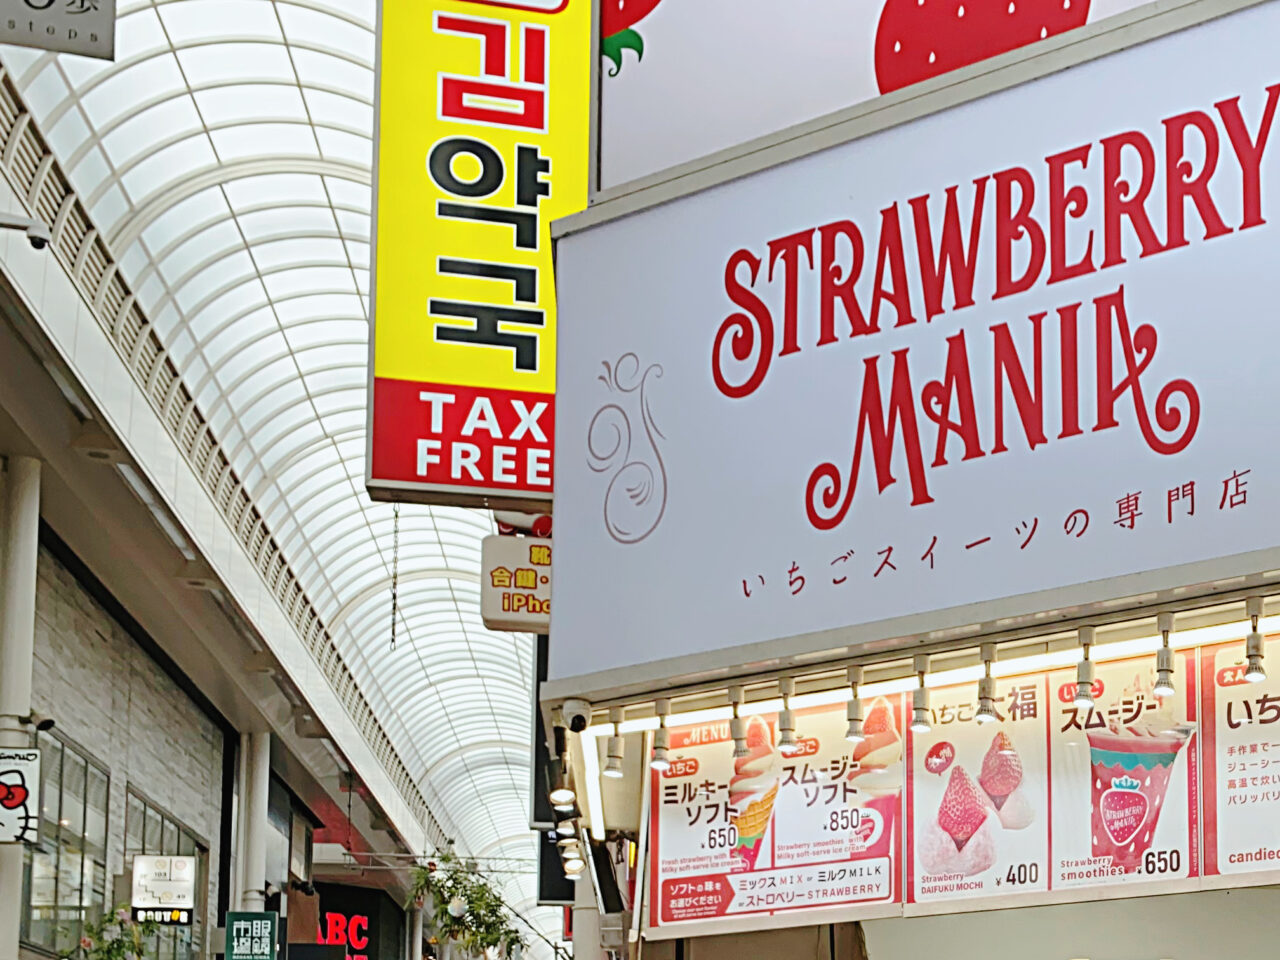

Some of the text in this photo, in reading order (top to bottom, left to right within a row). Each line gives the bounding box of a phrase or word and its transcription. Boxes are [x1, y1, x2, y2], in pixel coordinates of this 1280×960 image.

[419, 391, 549, 442] TAX
[805, 284, 1201, 531] MANIA
[416, 438, 551, 486] FREE
[742, 468, 1252, 597] いちごスイーツの専門店
[1061, 695, 1158, 733] スムージー
[782, 755, 859, 787] スムージー
[663, 779, 729, 805] ミルキー
[804, 782, 858, 808] ソフト
[686, 800, 739, 826] ソフト
[850, 866, 882, 878] MILK
[1061, 857, 1112, 869] Strawberry
[1061, 865, 1124, 881] smoothies
[921, 872, 964, 884] Strawberry
[921, 881, 983, 895] DAIFUKU MOCHI
[807, 883, 882, 900] STRAWBERRY
